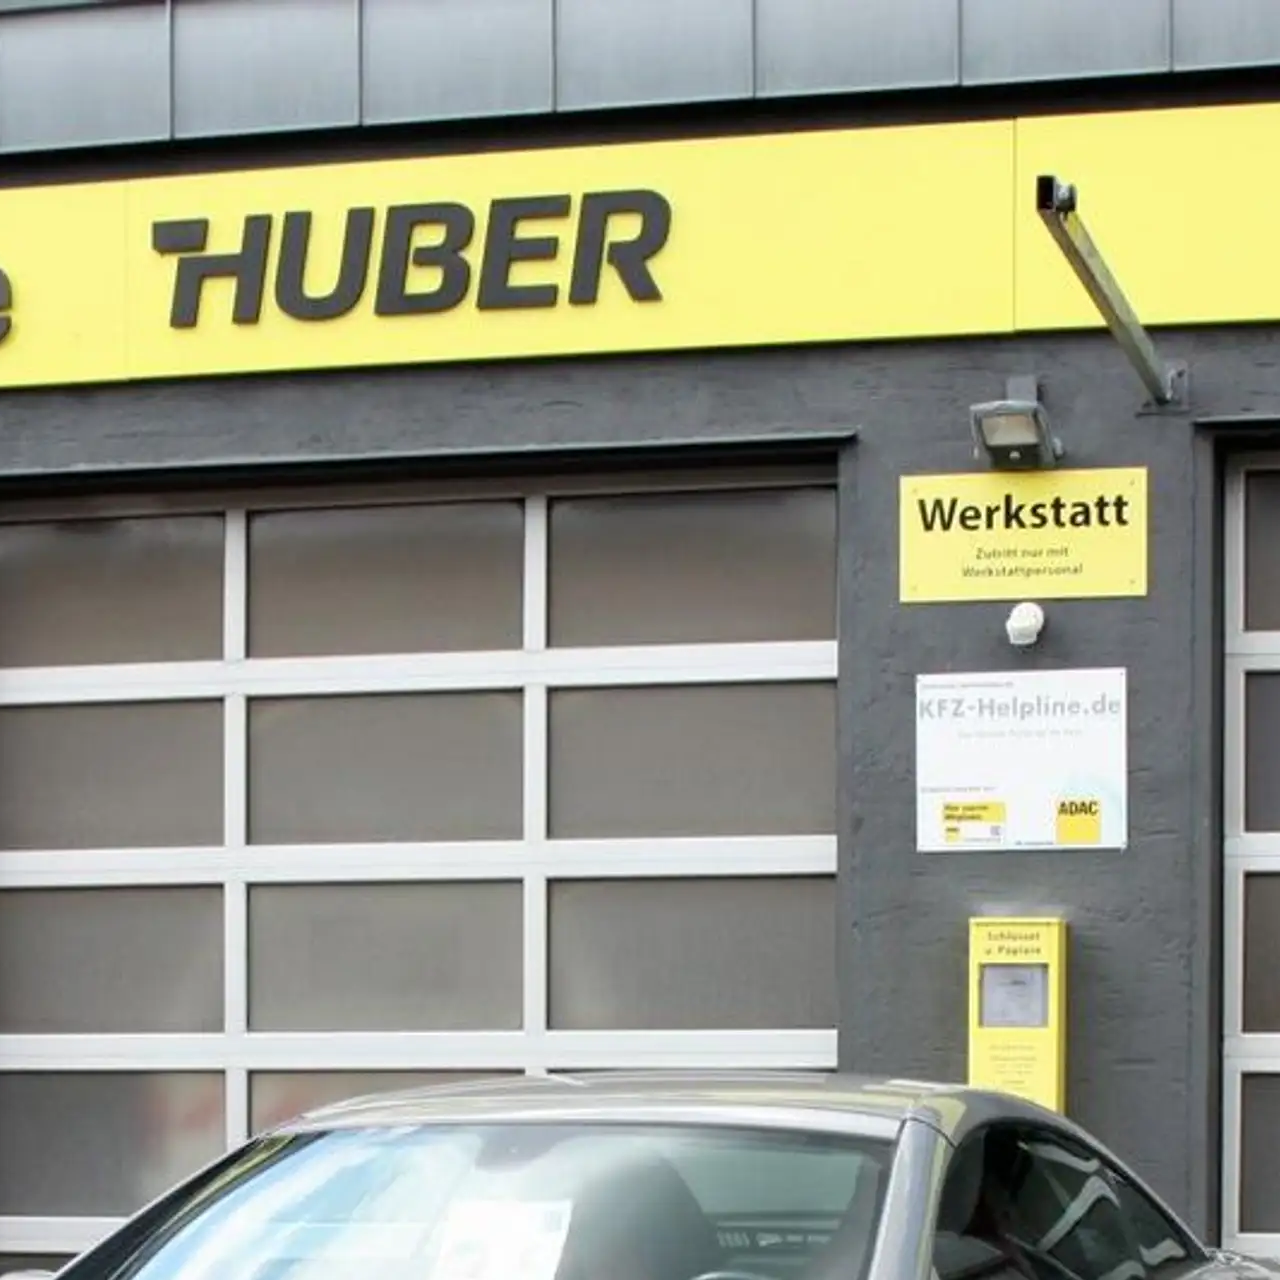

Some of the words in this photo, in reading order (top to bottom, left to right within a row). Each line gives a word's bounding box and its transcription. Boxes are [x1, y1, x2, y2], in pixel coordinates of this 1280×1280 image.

[151, 188, 672, 329] HUBER
[917, 494, 1130, 532] Werkstatt
[976, 547, 1018, 560] Zutritt
[1021, 548, 1044, 559] nur
[1046, 546, 1069, 558] mit
[962, 563, 1083, 578] Werkstattpersonal
[919, 692, 1121, 720] KFZ-Helpline.de
[1057, 800, 1101, 817] ADAC
